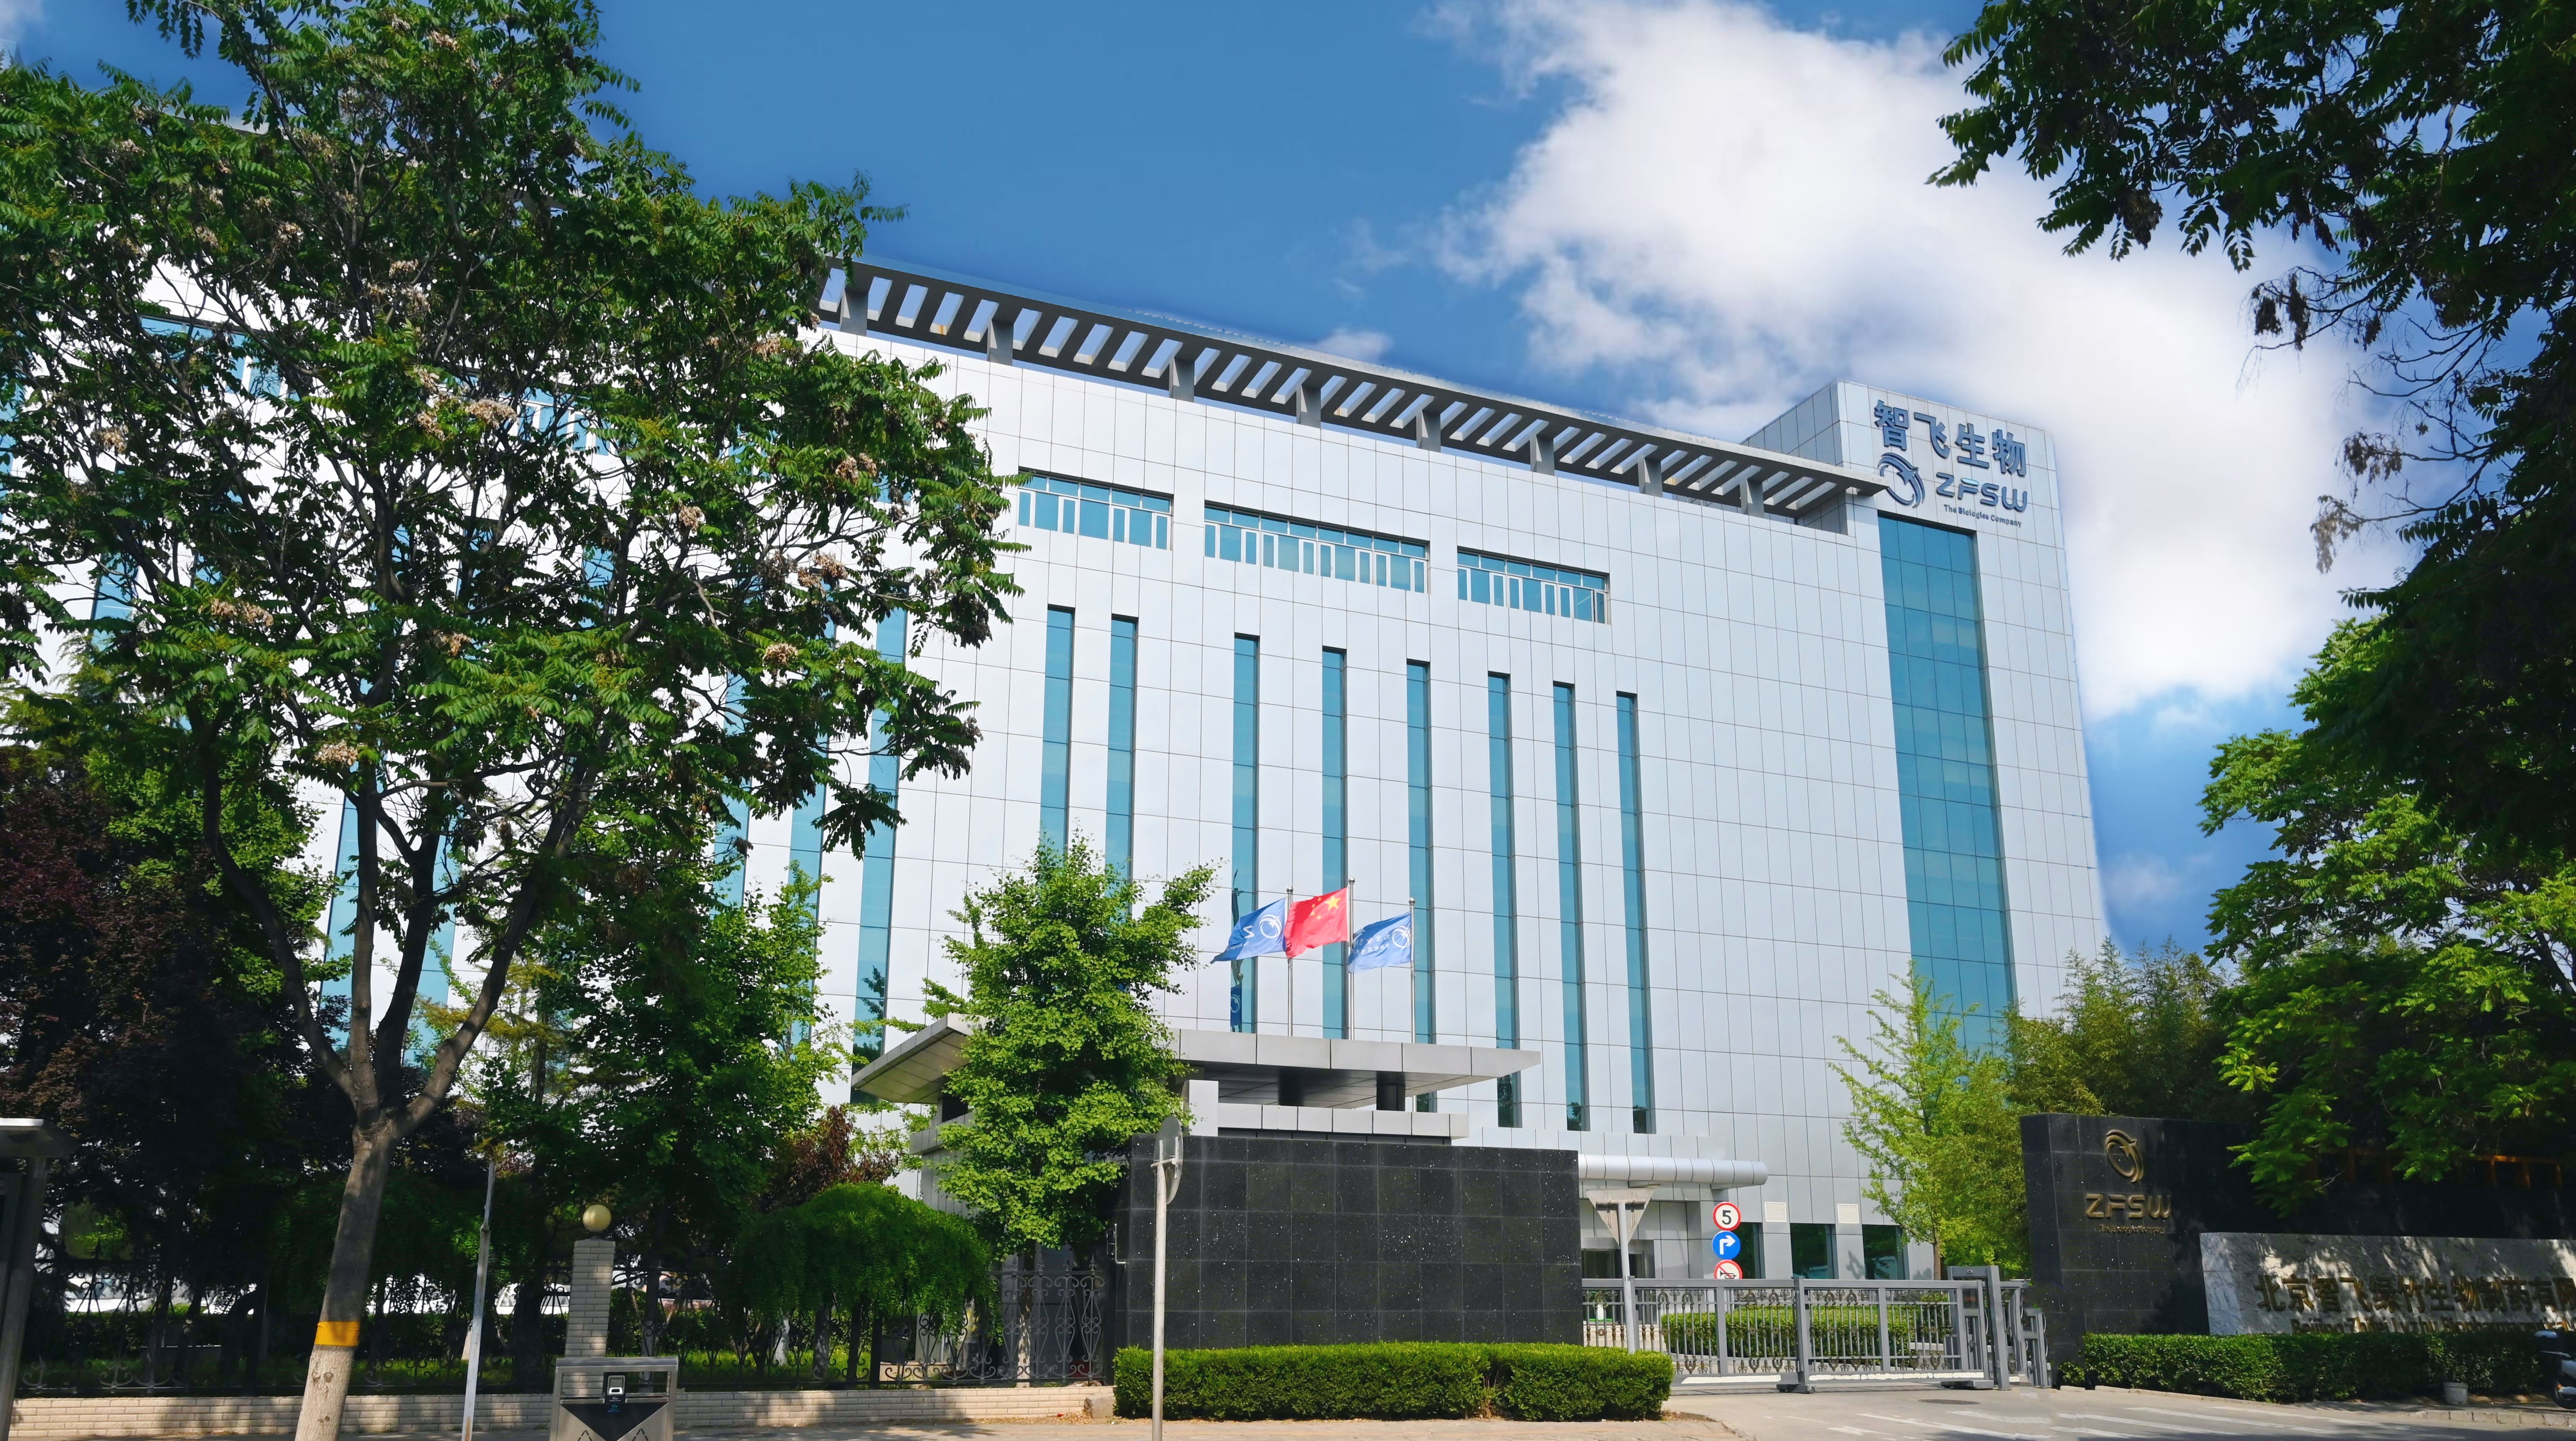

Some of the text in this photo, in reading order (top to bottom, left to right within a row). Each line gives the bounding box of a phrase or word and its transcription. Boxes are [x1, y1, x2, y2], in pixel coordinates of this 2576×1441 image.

[1874, 399, 2027, 477] 智飞生物
[1936, 472, 2028, 512] ZFSW
[1944, 504, 2022, 528] The Biologics Company
[1722, 1210, 1731, 1224] 5
[2085, 1193, 2170, 1219] ZFSW
